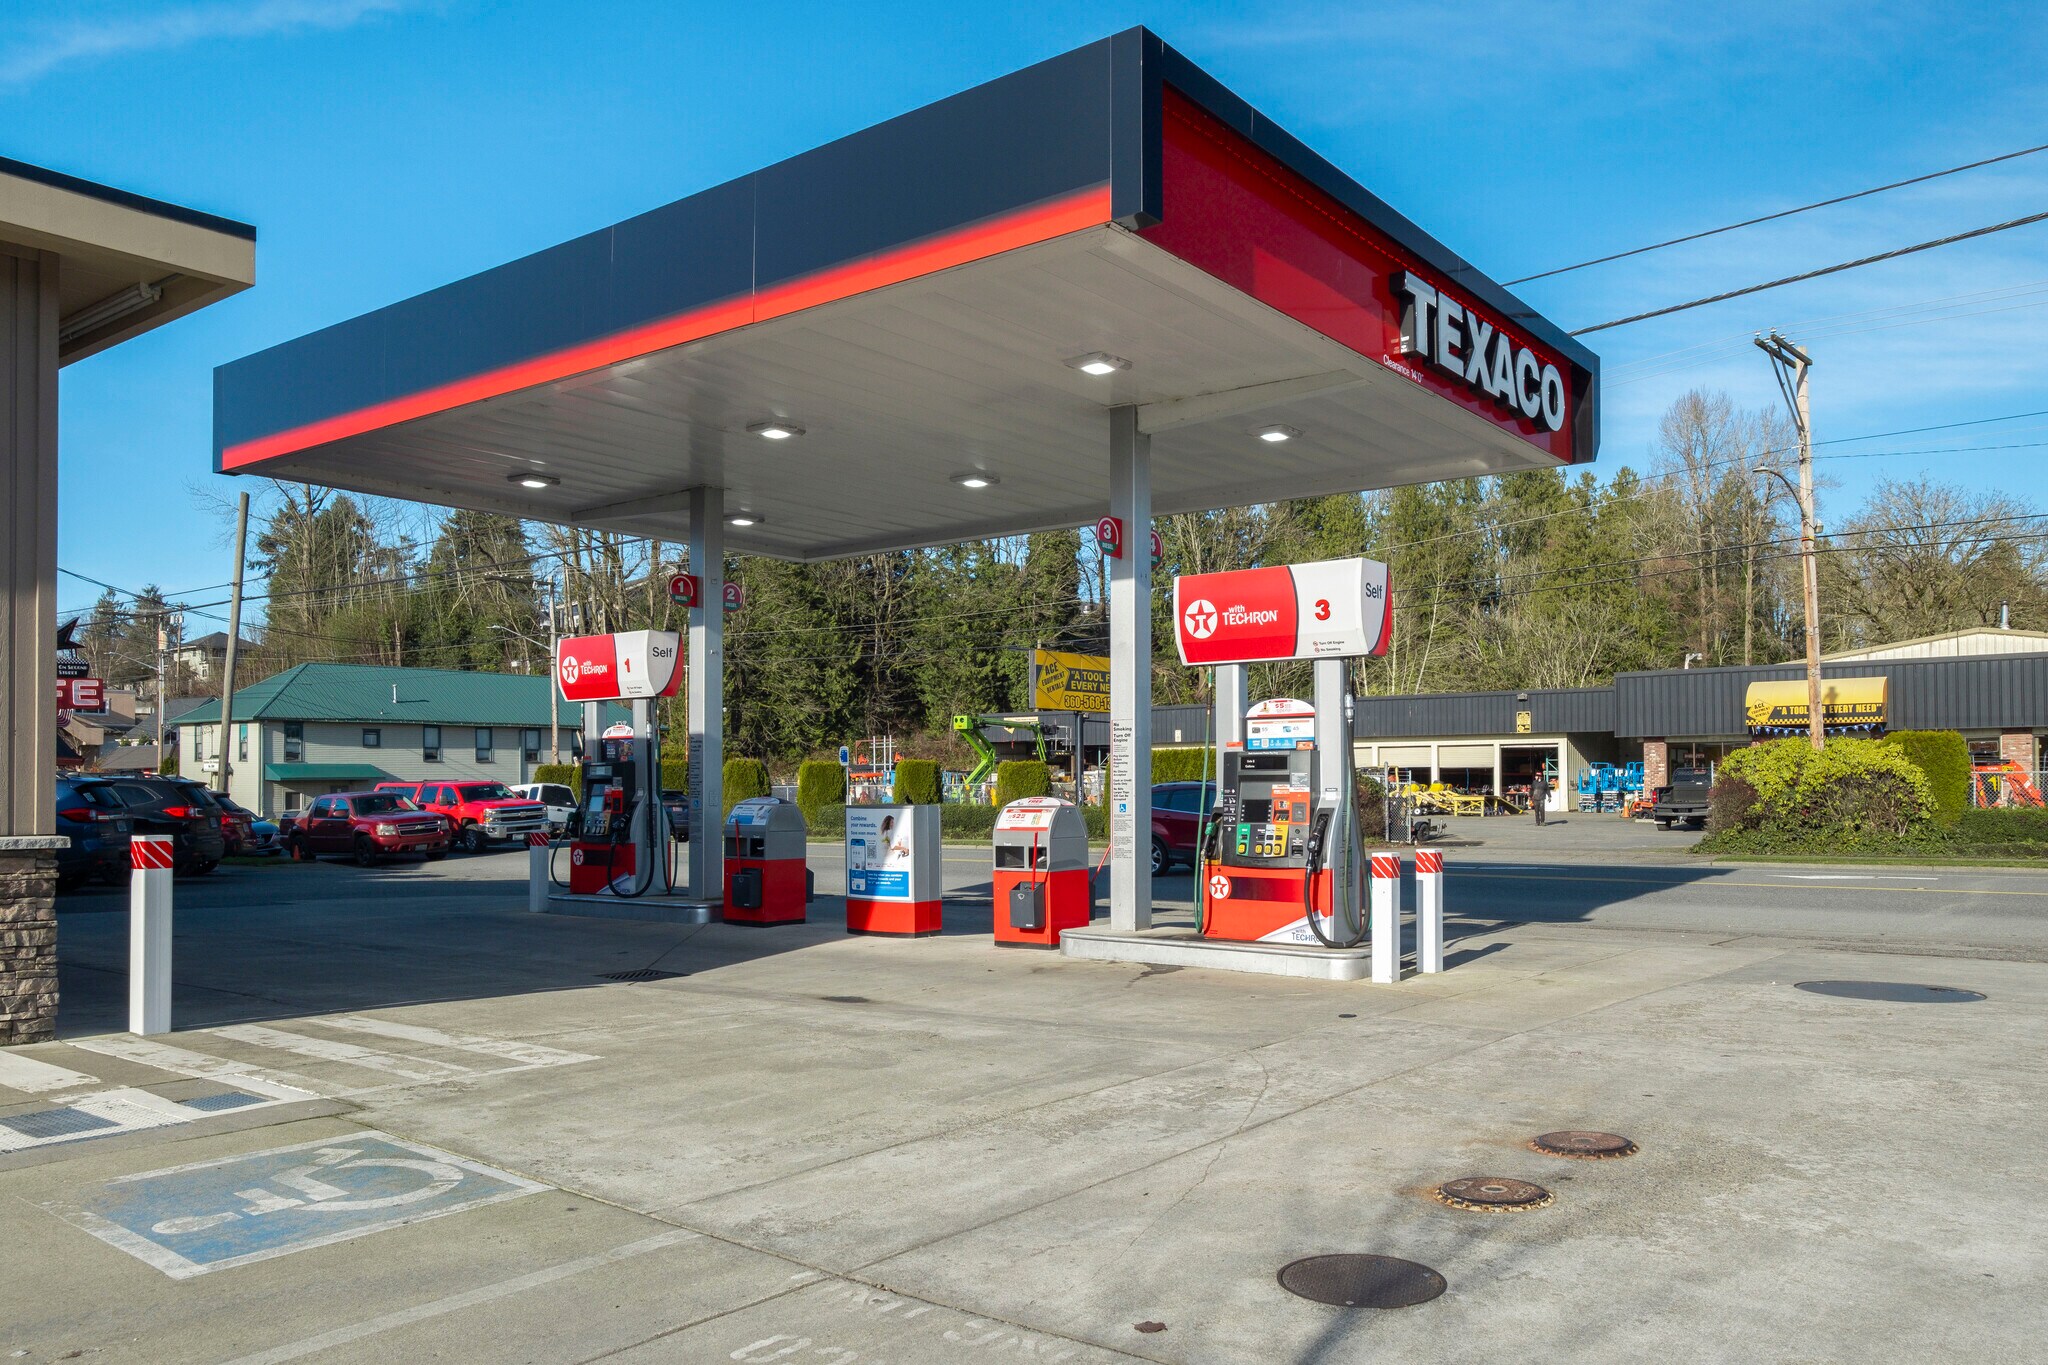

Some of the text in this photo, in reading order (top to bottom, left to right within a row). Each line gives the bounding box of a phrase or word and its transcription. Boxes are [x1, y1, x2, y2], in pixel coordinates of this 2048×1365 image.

[1403, 269, 1566, 432] TEXACO
[1383, 354, 1410, 377] Clearance
[1103, 524, 1112, 540] 3
[677, 581, 684, 593] 1
[1365, 582, 1382, 599] Self
[726, 588, 735, 600] 2
[1228, 604, 1245, 613] with
[1314, 599, 1331, 621] 3
[1221, 610, 1277, 626] TECHRON
[652, 646, 673, 658] Self
[580, 664, 608, 675] TECHRON
[624, 658, 631, 673] 1
[1045, 661, 1058, 676] ACE
[1082, 671, 1103, 682] TOOL
[1071, 680, 1111, 692] EVERY NE
[1790, 705, 1809, 714] TOOL
[1829, 704, 1854, 713] EVERY
